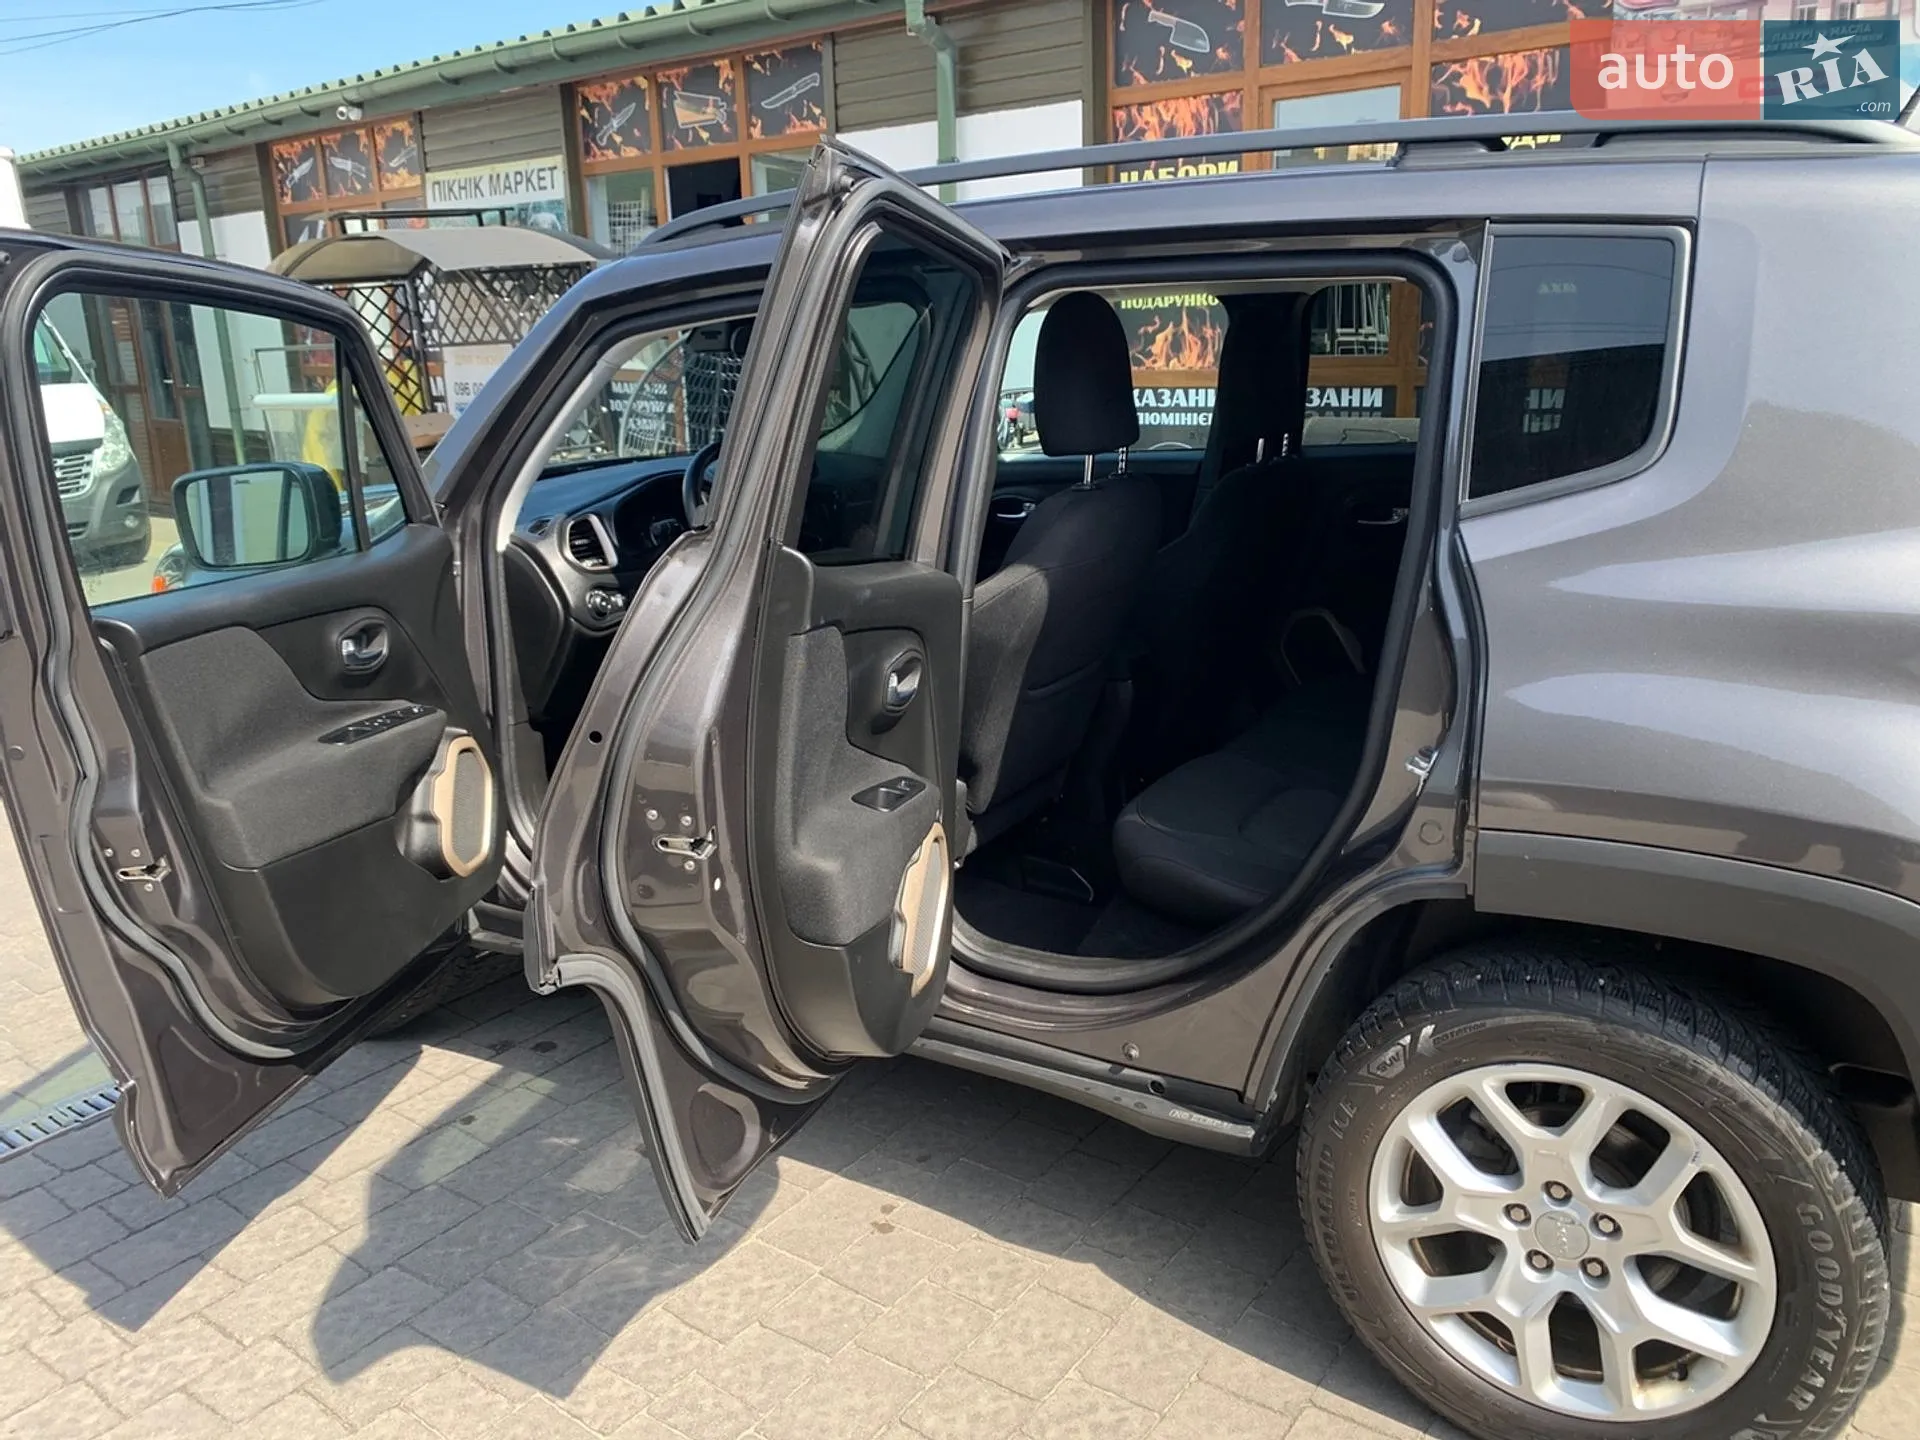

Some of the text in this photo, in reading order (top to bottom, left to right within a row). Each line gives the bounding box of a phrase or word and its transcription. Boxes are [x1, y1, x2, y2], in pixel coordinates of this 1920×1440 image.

[431, 166, 557, 203] ПІКНІК МАРКЕТ
[1375, 1050, 1402, 1073] SUV
[1328, 1098, 1358, 1140] ICE
[1787, 1203, 1847, 1412] GOODYEAR
